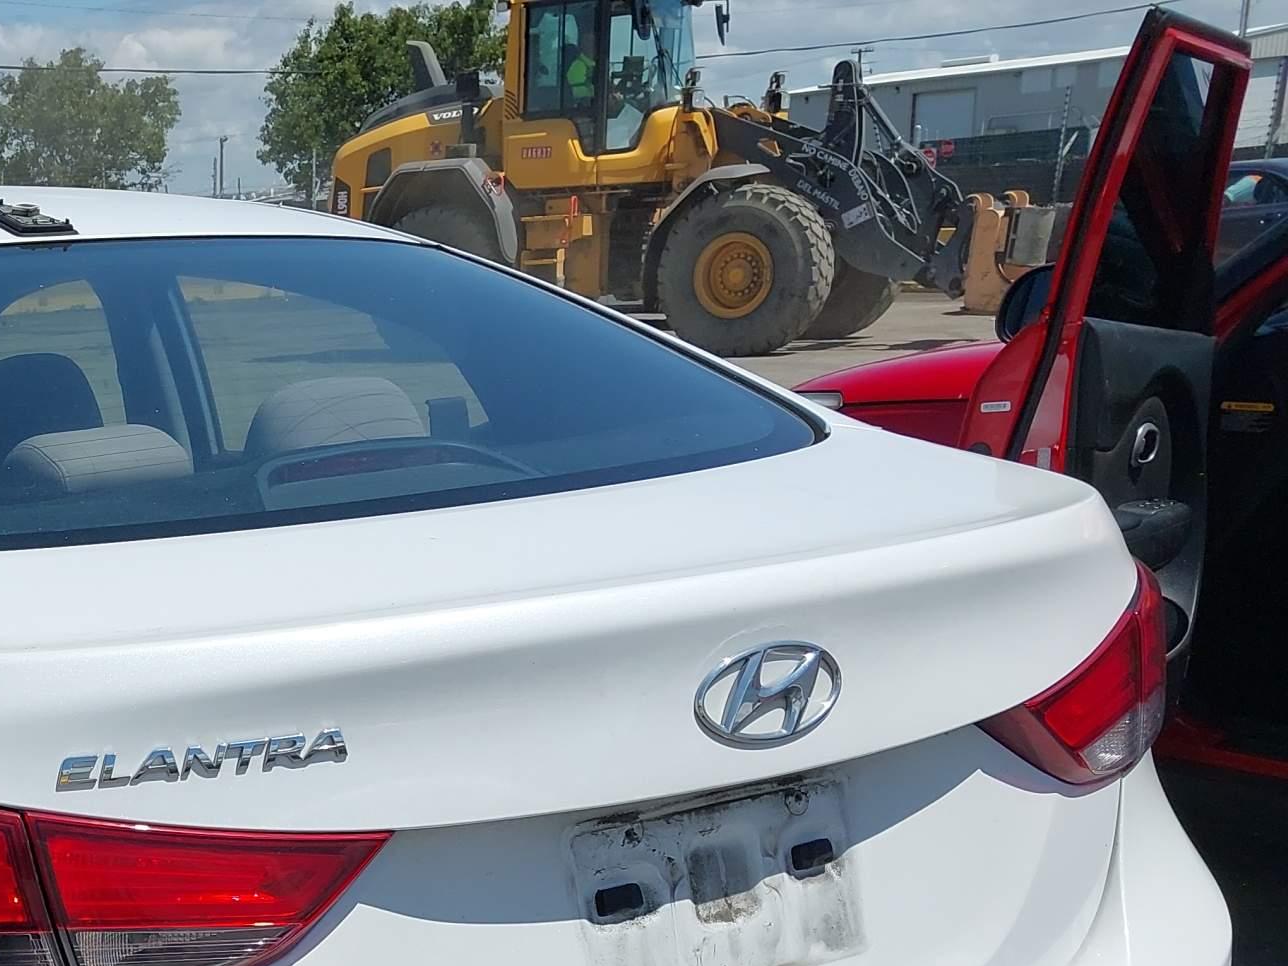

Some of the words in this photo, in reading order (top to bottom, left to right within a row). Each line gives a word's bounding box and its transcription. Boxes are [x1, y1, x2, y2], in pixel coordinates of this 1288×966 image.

[801, 143, 817, 155] NO
[816, 150, 850, 172] CAMINE
[848, 168, 869, 201] DEBAJO
[337, 191, 348, 215] L90H
[796, 179, 813, 194] DEL
[812, 188, 841, 210] MÁSTIL
[55, 727, 348, 793] ELANTRA
